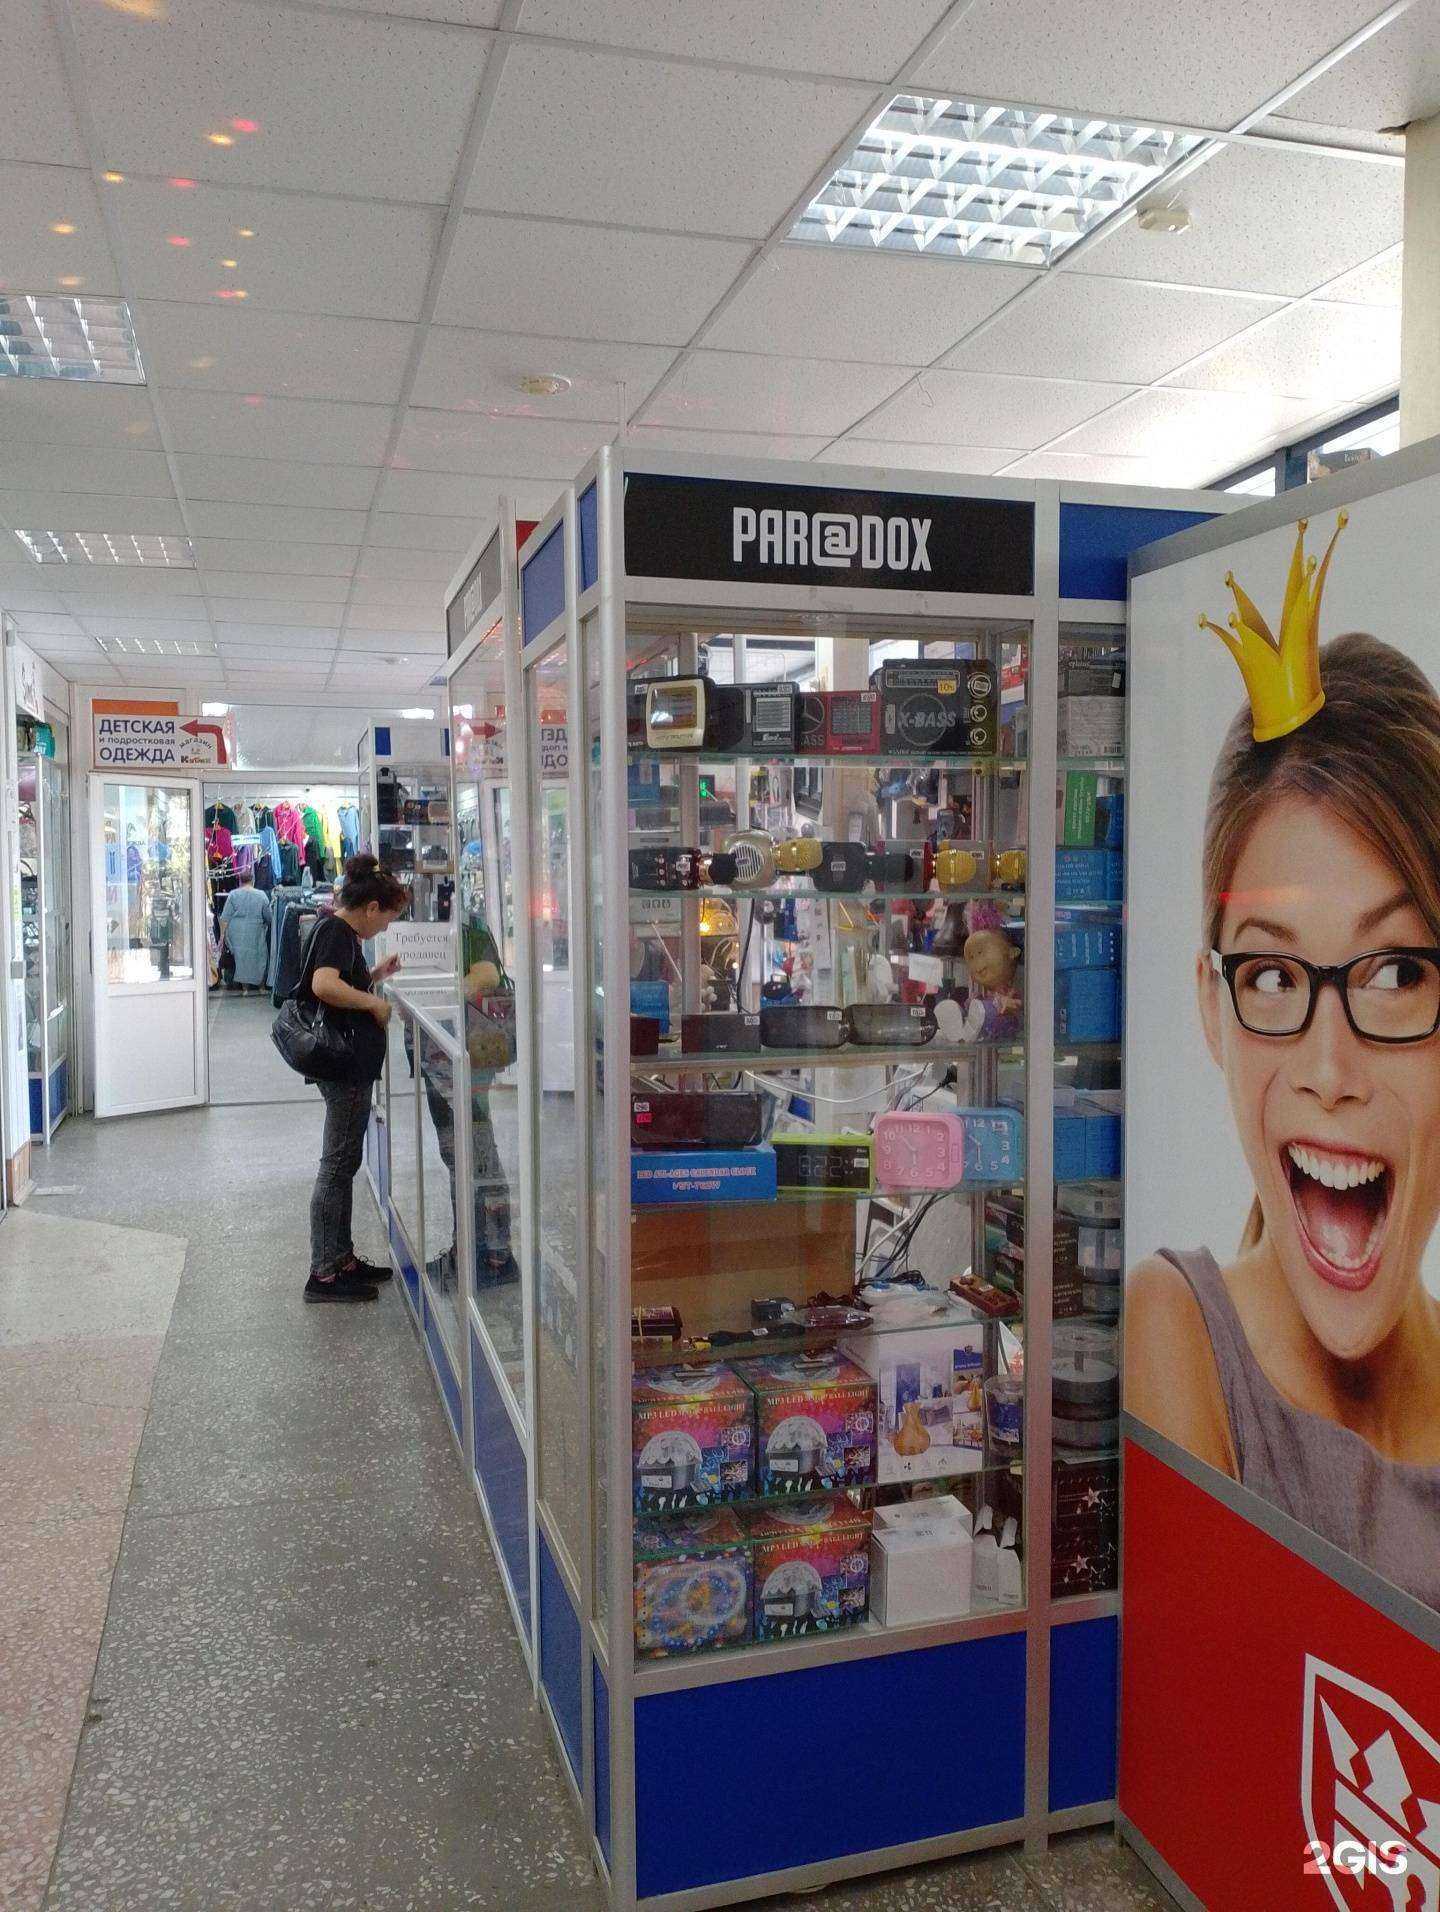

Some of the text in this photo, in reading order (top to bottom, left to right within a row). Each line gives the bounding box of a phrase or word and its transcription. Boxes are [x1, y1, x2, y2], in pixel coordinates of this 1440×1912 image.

[732, 506, 932, 572] PAR@DOX
[99, 719, 175, 735] ДЕТСКАЯ
[901, 711, 956, 728] X-BASS
[107, 736, 175, 747] подростковая
[180, 736, 213, 751] магазин
[100, 747, 175, 764] ОДЕЖДА
[396, 932, 448, 944] Требуется
